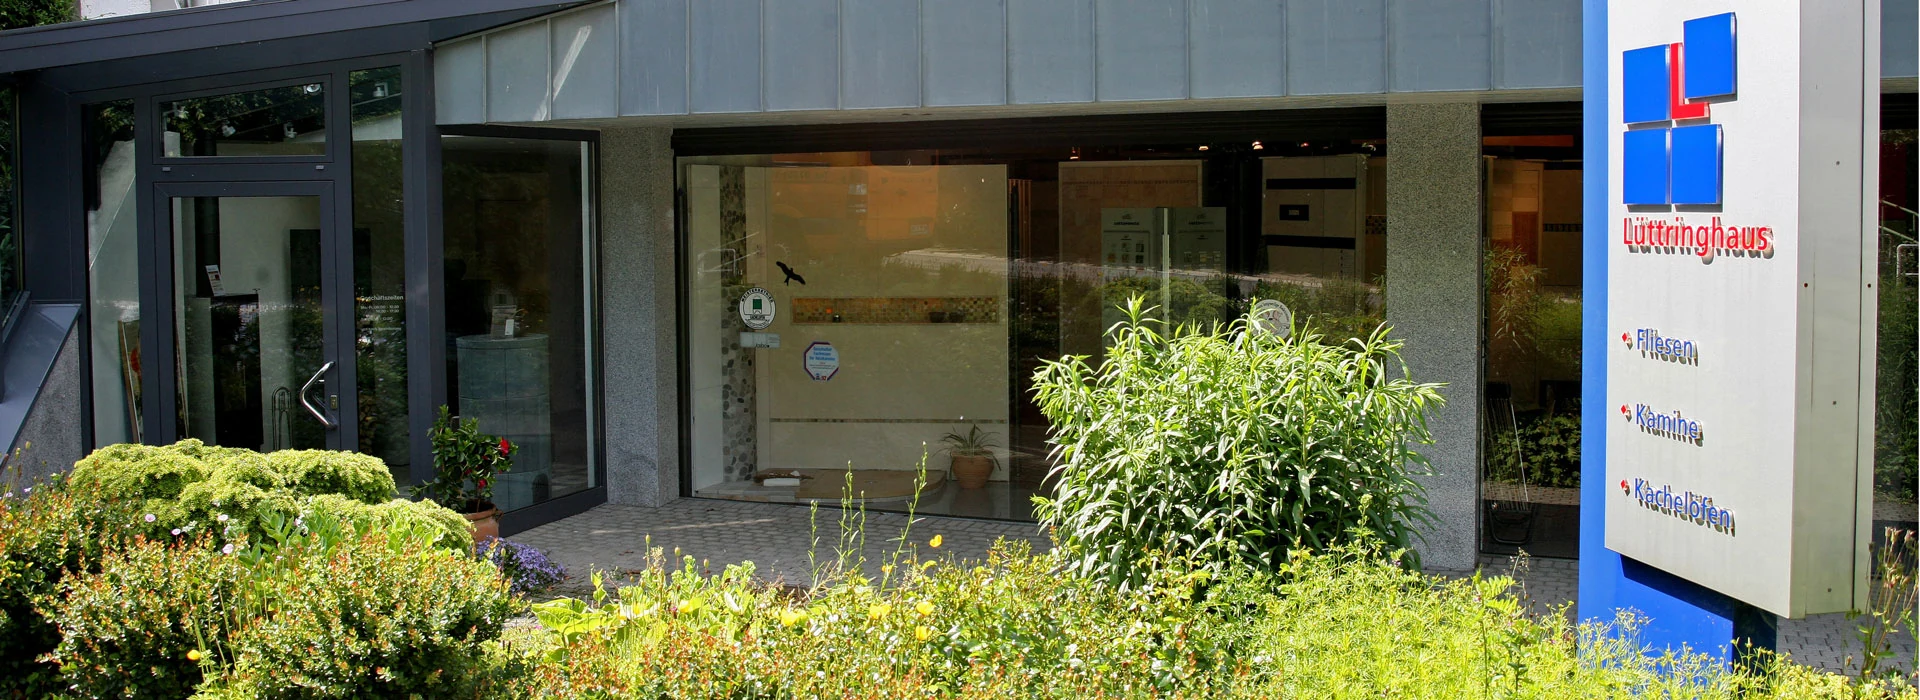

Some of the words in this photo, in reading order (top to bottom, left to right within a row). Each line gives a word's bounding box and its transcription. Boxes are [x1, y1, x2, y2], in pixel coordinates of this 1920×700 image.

[1623, 216, 1769, 257] Lüttringhaus
[1637, 328, 1694, 358] Fliesen
[1636, 403, 1698, 439] Kamine
[1634, 478, 1730, 528] Kachelöfen
